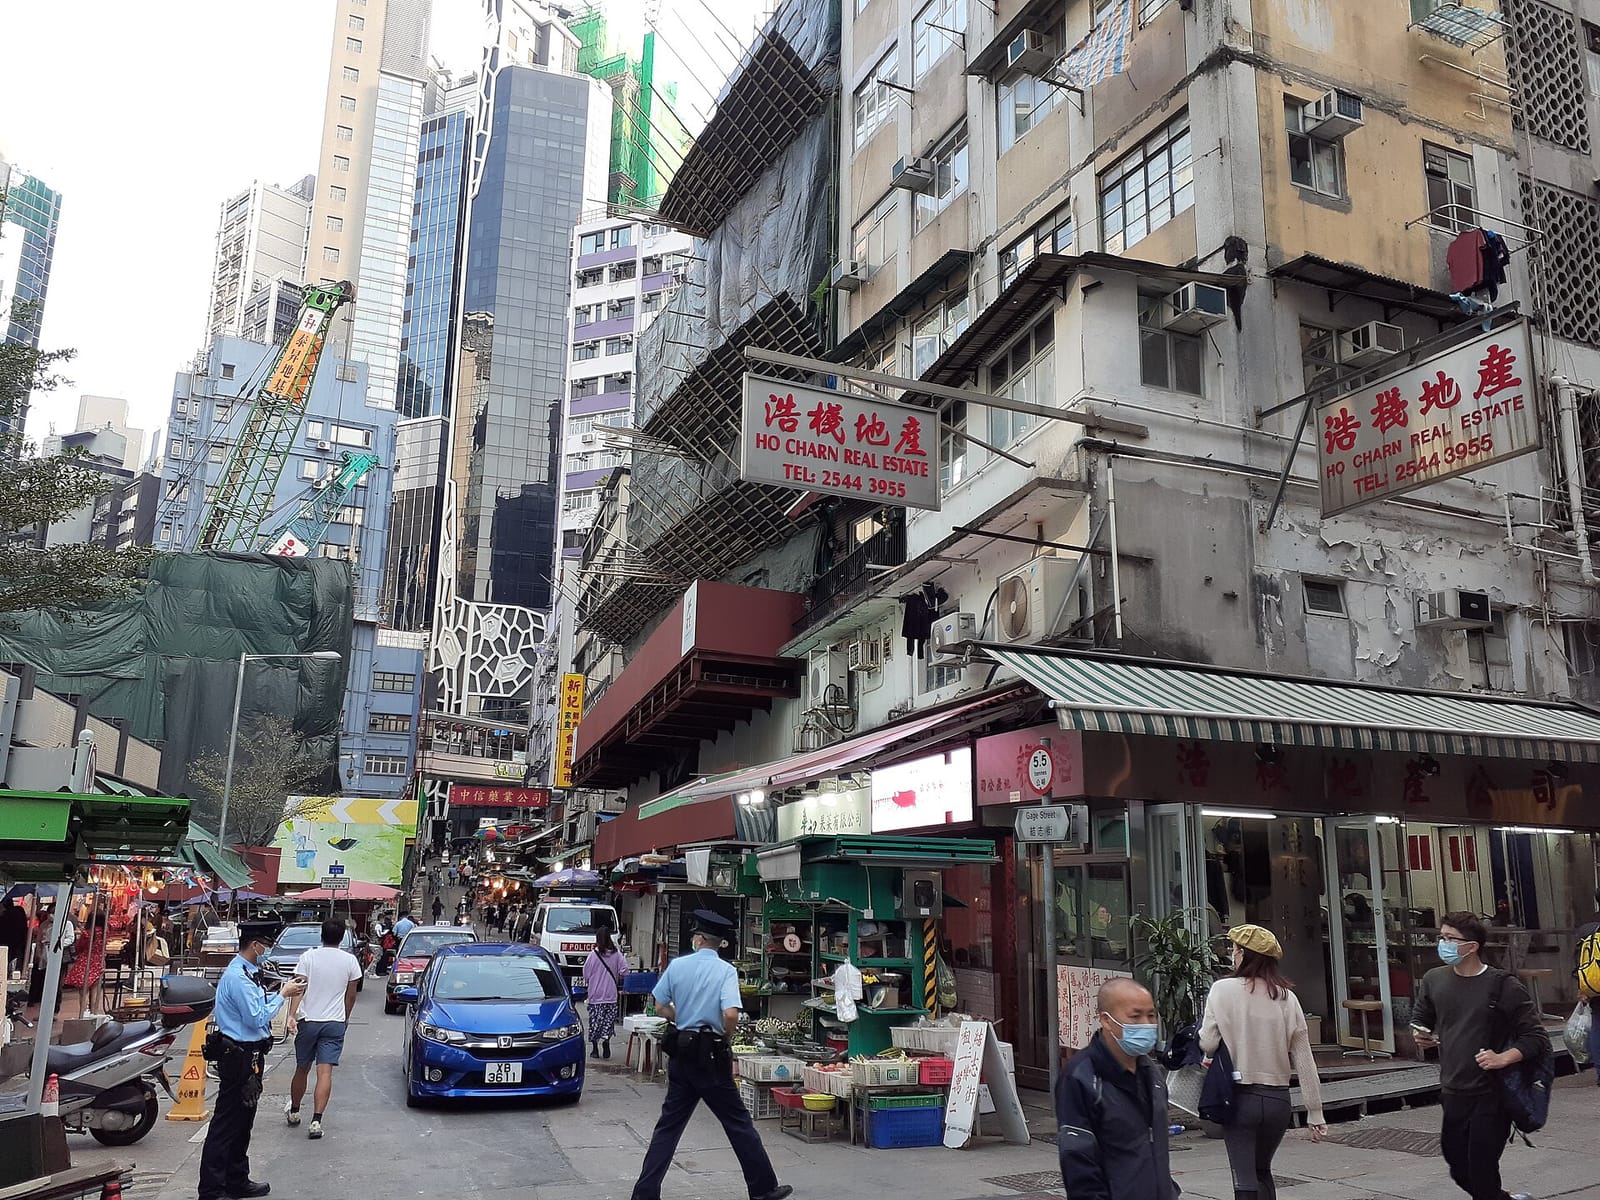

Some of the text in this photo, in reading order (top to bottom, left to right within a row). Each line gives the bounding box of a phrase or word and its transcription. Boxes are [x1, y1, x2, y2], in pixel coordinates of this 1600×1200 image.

[1326, 394, 1525, 479] HO CHARN REAL ESTATE
[756, 432, 929, 477] HO CHARN REAL ESTATE
[1395, 453, 1440, 482] 2544
[1444, 433, 1493, 464] 3955
[783, 463, 907, 498] TEL: 2544 3955
[567, 679, 581, 708] 新記
[1033, 754, 1047, 768] 5.5
[460, 789, 542, 804] 中信藥業公司
[1026, 810, 1056, 821] Gage Street
[569, 943, 595, 951] POLICE
[496, 1063, 511, 1073] XB
[488, 1072, 516, 1082] 3611
